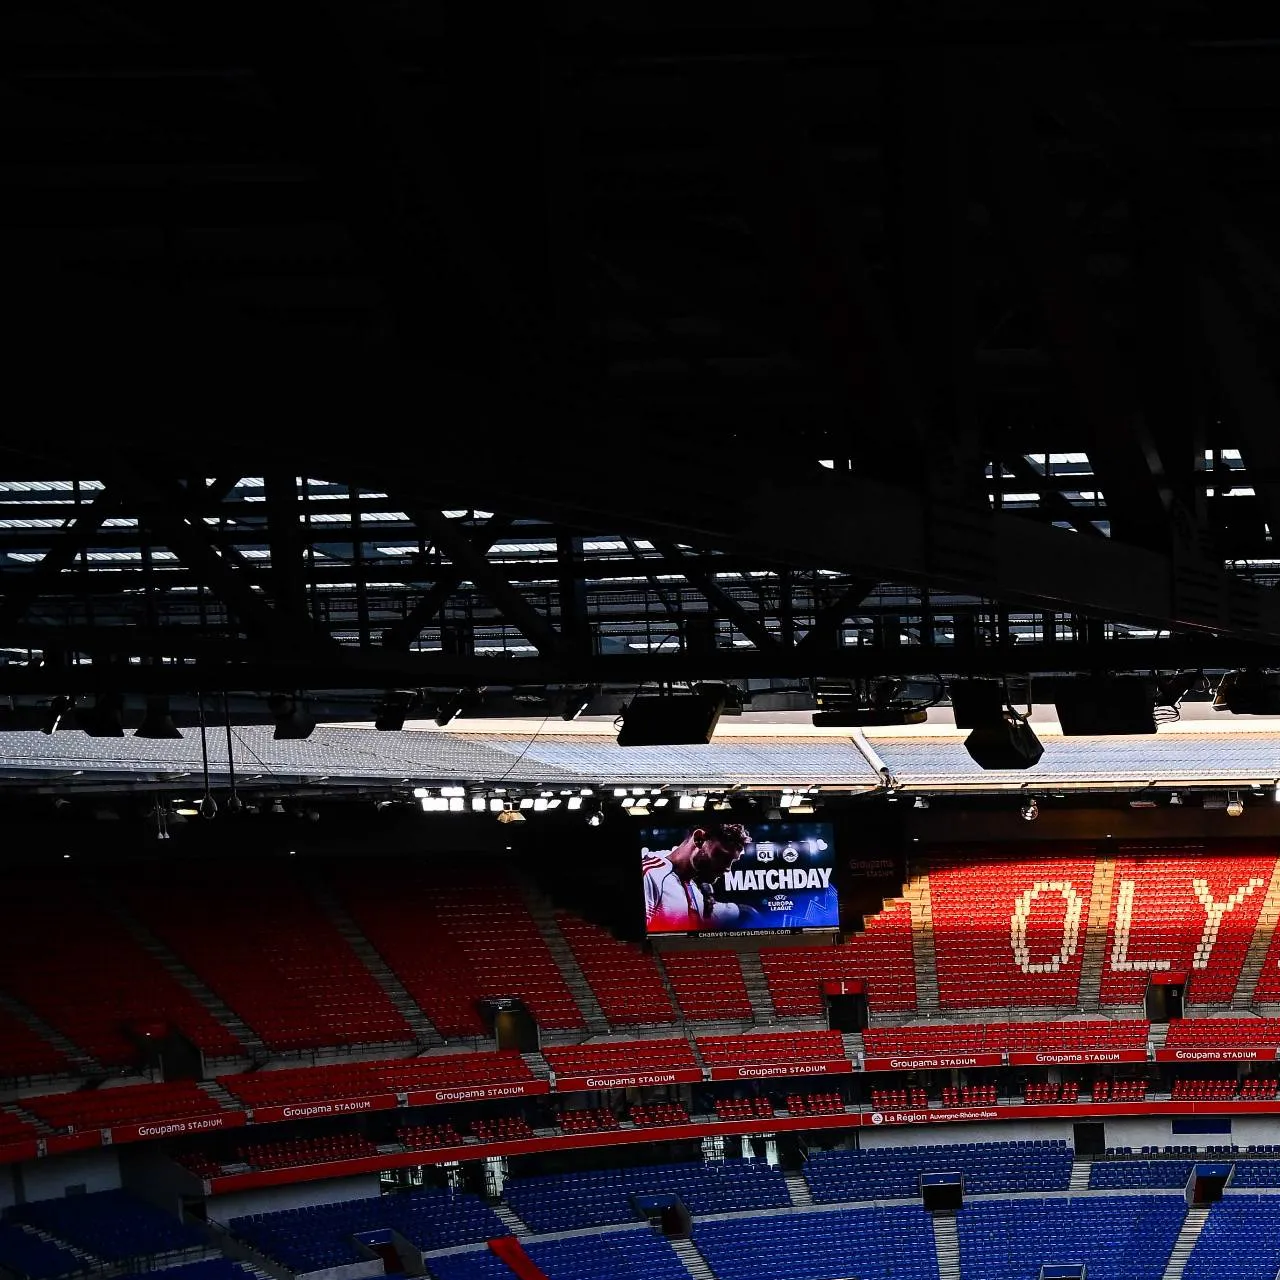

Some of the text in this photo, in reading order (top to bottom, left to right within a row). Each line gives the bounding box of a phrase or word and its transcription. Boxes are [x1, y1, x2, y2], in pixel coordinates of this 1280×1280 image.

[724, 868, 832, 891] MATCHDAY
[1036, 1053, 1120, 1064] Groupama STADIUM
[1176, 1050, 1257, 1061] Groupama STADIUM
[738, 1064, 826, 1078] Groupama STADIUM
[890, 1058, 977, 1070] Groupama STADIUM
[586, 1074, 675, 1088] Groupama STADIUM
[435, 1086, 524, 1101] Groupama STADIUM
[283, 1101, 371, 1117] Groupama STADIUM
[884, 1114, 897, 1122] La
[898, 1112, 927, 1123] Région
[138, 1118, 223, 1137] Groupama STADIUM
